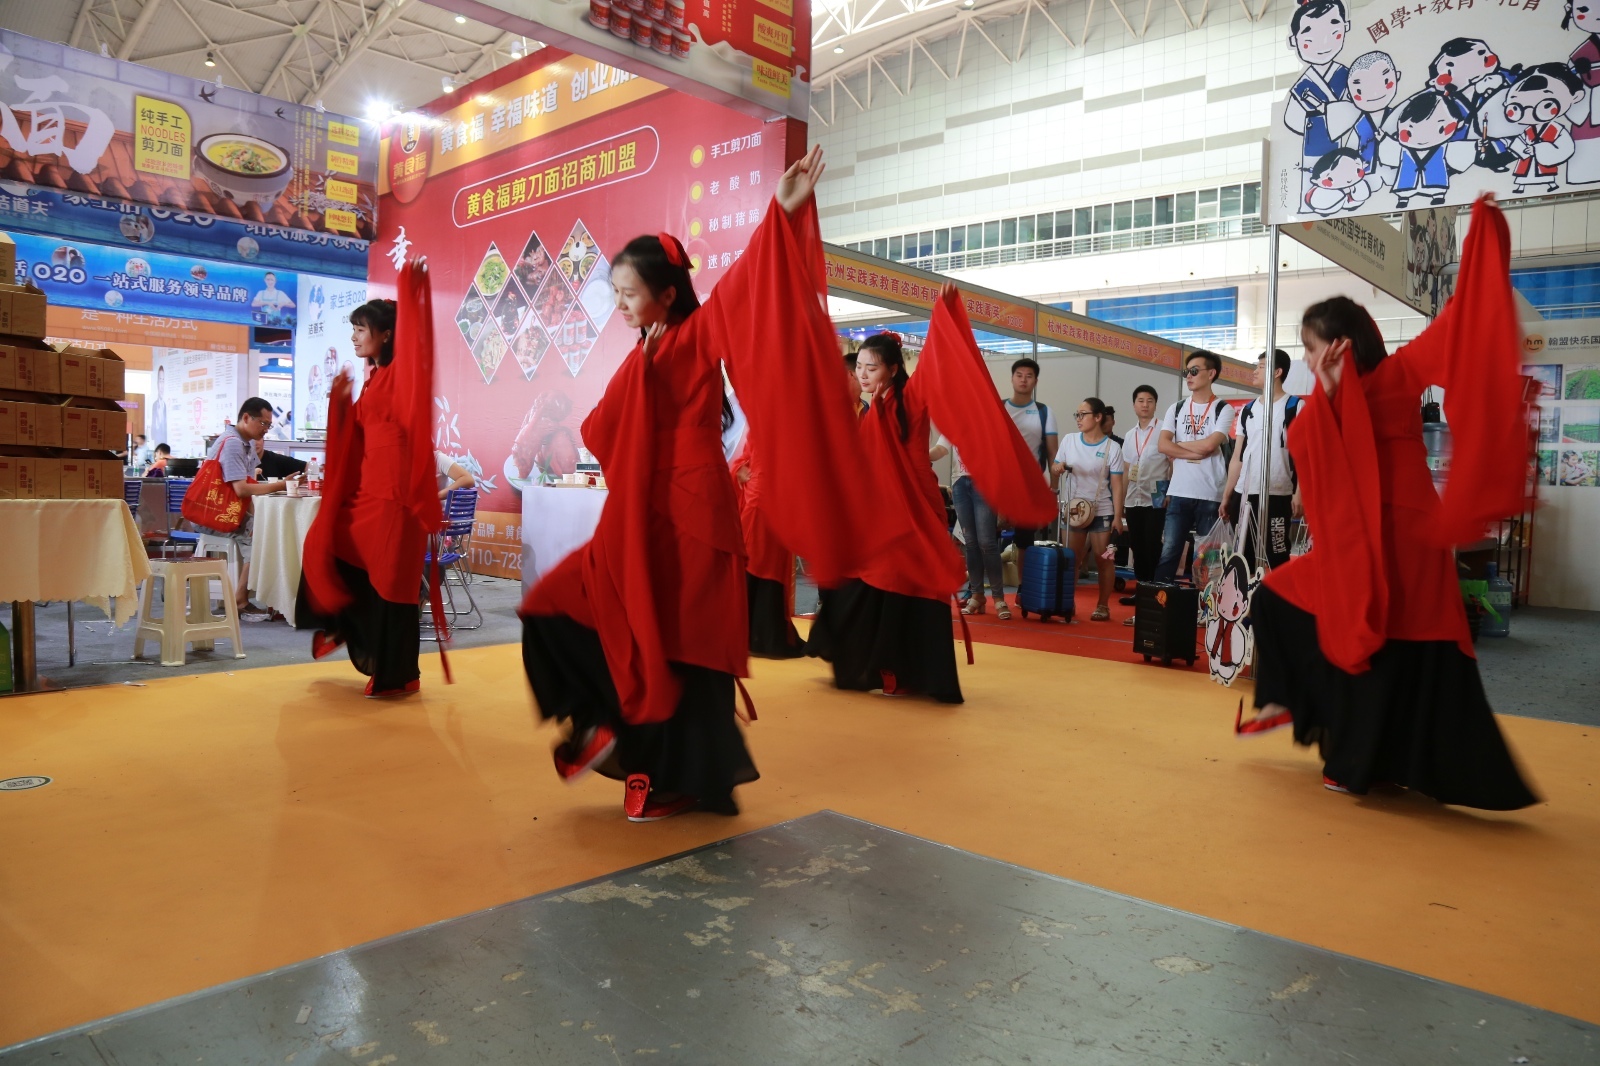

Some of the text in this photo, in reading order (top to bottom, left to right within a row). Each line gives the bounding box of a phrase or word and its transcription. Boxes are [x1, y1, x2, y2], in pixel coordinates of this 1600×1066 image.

[757, 23, 788, 44] 酸爽开胃
[757, 65, 787, 85] 味道鲜美
[141, 108, 183, 129] 纯手工
[440, 113, 485, 154] 黄食福
[491, 82, 559, 133] 幸福味道
[570, 62, 638, 102] 创业加
[141, 125, 186, 143] NOODLES
[142, 137, 183, 157] 剪刀面
[710, 131, 762, 159] 手工剪刀面
[393, 152, 427, 180] 黄食福
[466, 142, 637, 219] 黄食福剪刀面招商加盟
[708, 208, 760, 232] 秘制猪蹄
[94, 272, 248, 303] 一站式服务领导品牌
[1048, 319, 1131, 351] 杭州实践家教育咨询有限公司
